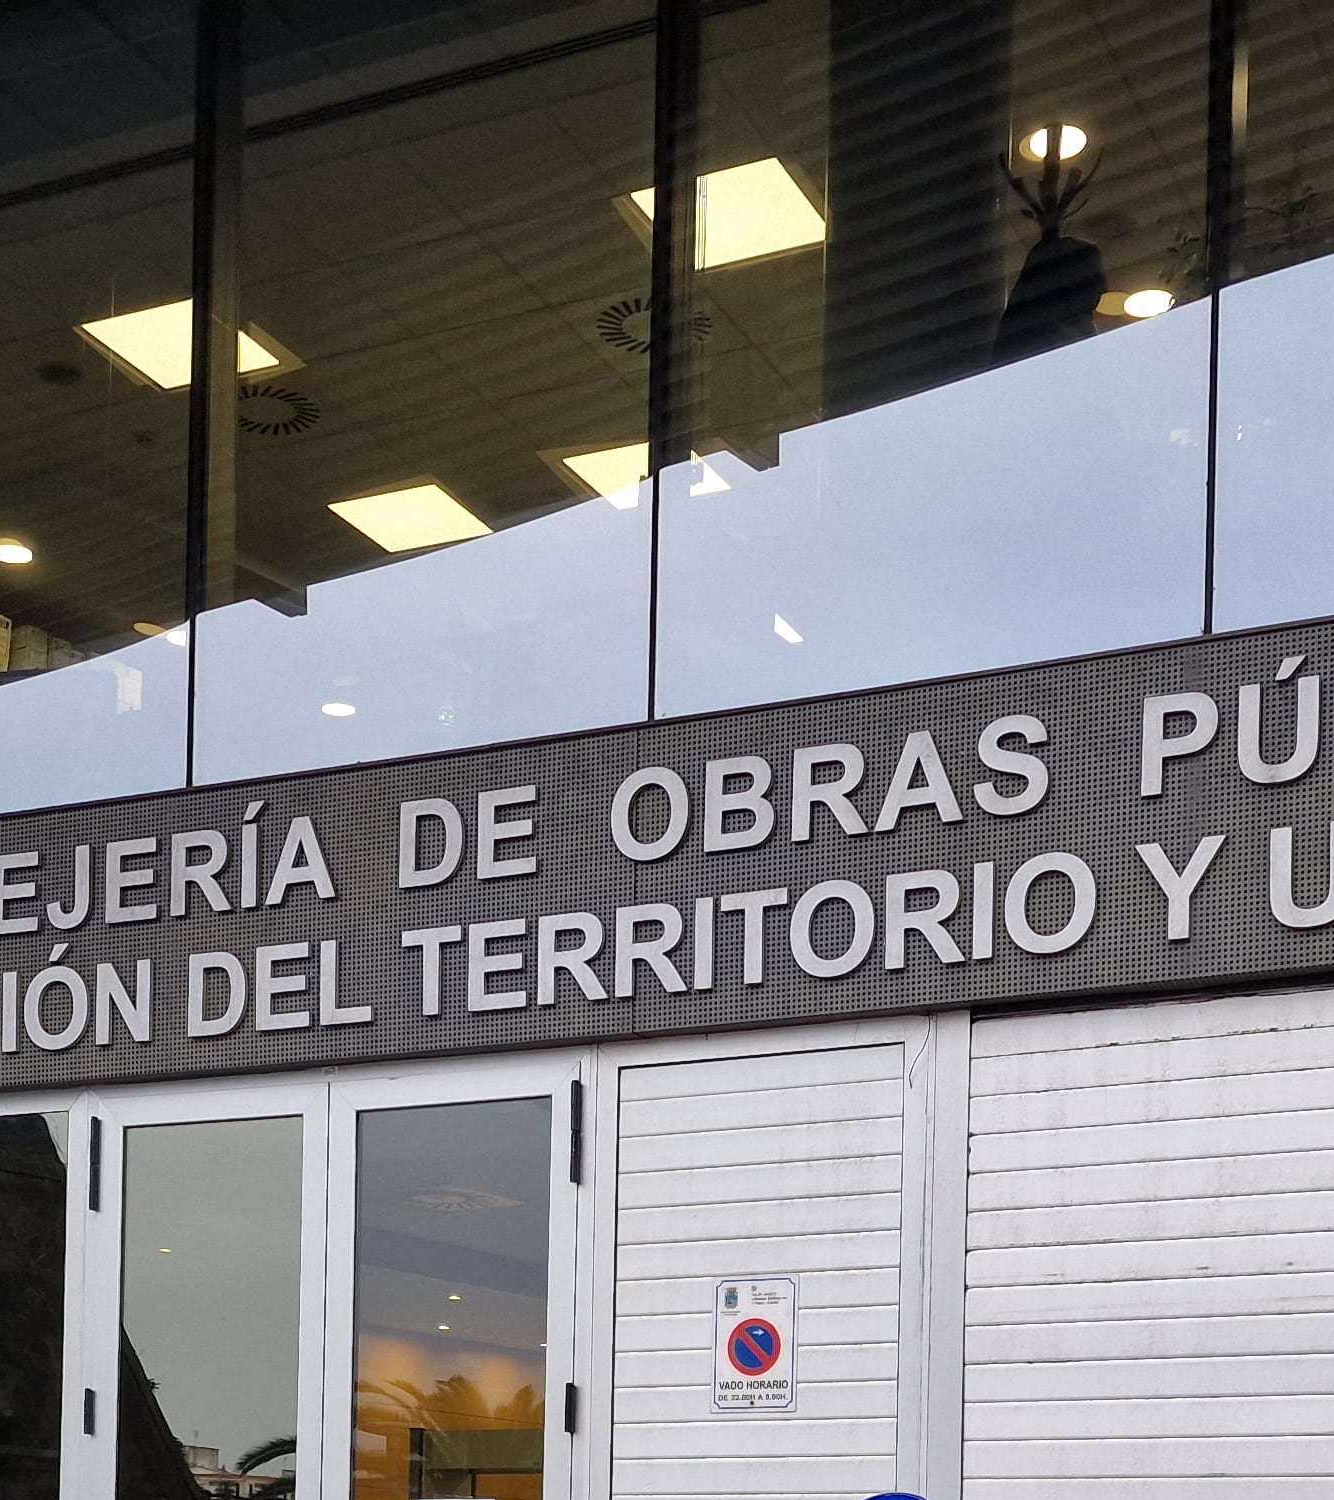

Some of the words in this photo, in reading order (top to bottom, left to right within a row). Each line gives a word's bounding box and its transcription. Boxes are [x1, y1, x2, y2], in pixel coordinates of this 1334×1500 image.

[398, 785, 538, 888] DE
[610, 714, 1050, 861] OBRAS
[187, 938, 373, 1038] DEL
[401, 851, 1097, 1017] TERRITORIO
[1137, 835, 1224, 941] Y
[719, 1381, 744, 1390] VADO
[747, 1380, 788, 1390] HORARIO
